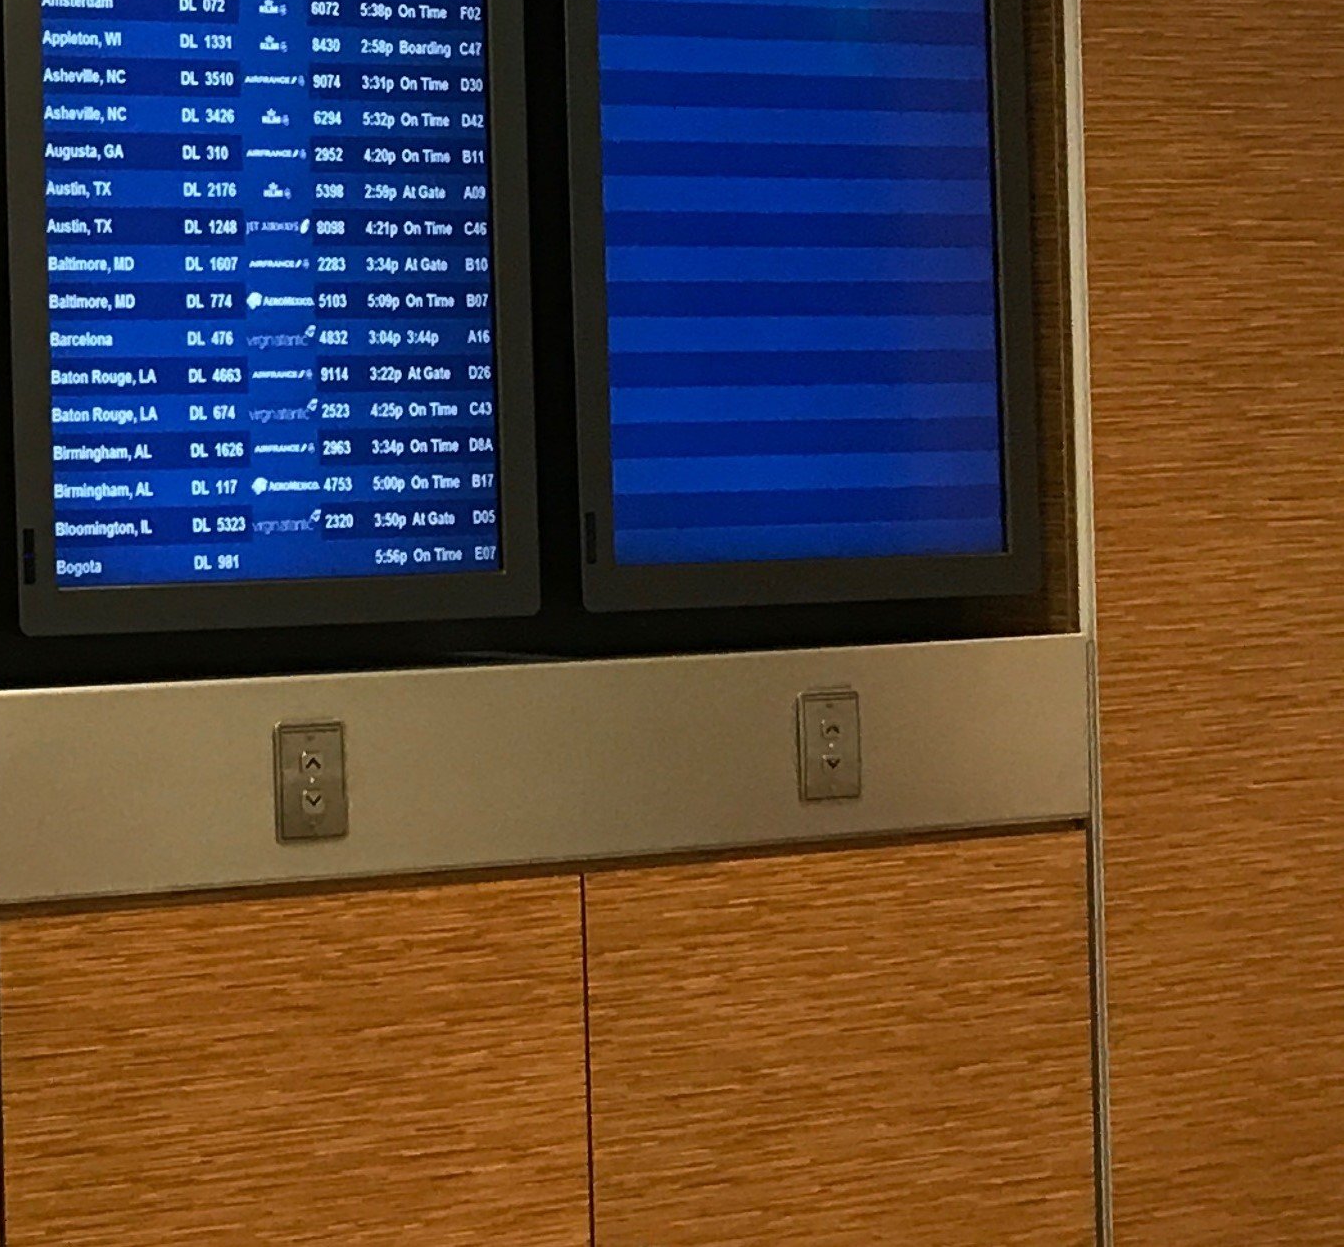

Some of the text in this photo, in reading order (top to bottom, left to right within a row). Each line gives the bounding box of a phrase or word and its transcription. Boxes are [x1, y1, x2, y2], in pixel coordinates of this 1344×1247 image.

[460, 5, 480, 20] F02
[41, 29, 481, 58] Appleton, WI DL 1331 Boarding C47
[42, 67, 394, 93] Asheville, NC 3:31p
[43, 105, 483, 129] Asheville, NC 5:32p D42
[44, 142, 484, 165] Augusta, GA DL 310 2952 4:20p On Time B11
[45, 180, 111, 198] Austin, TX
[46, 218, 398, 238] Austin, TX 4:21p
[47, 256, 447, 274] Baltimore, MD DL 3:34p Gate
[48, 293, 347, 311] Baltimore, MD 774 5103
[49, 331, 112, 346] Barcelona
[210, 330, 233, 345] 476
[368, 329, 401, 347] 3:04p
[406, 329, 438, 346] 3:44p
[50, 365, 451, 386] Baton Rouge, LA DL 9114 3:22p Gate
[51, 407, 89, 422] Baton
[92, 406, 137, 424] Rouge,
[139, 405, 157, 421] LA
[212, 404, 235, 419] 674
[321, 403, 349, 418] 2523
[370, 402, 403, 419] 4:25p
[52, 439, 404, 463] Birmingham, AL 3:34p
[53, 473, 493, 500] Birmingham, AL DL 117 4753 On Time B17
[54, 520, 138, 538] Bloomington,
[140, 519, 152, 534] IL
[216, 516, 245, 532] 5323
[373, 512, 406, 529] 3:50p
[56, 559, 102, 577] Bogota
